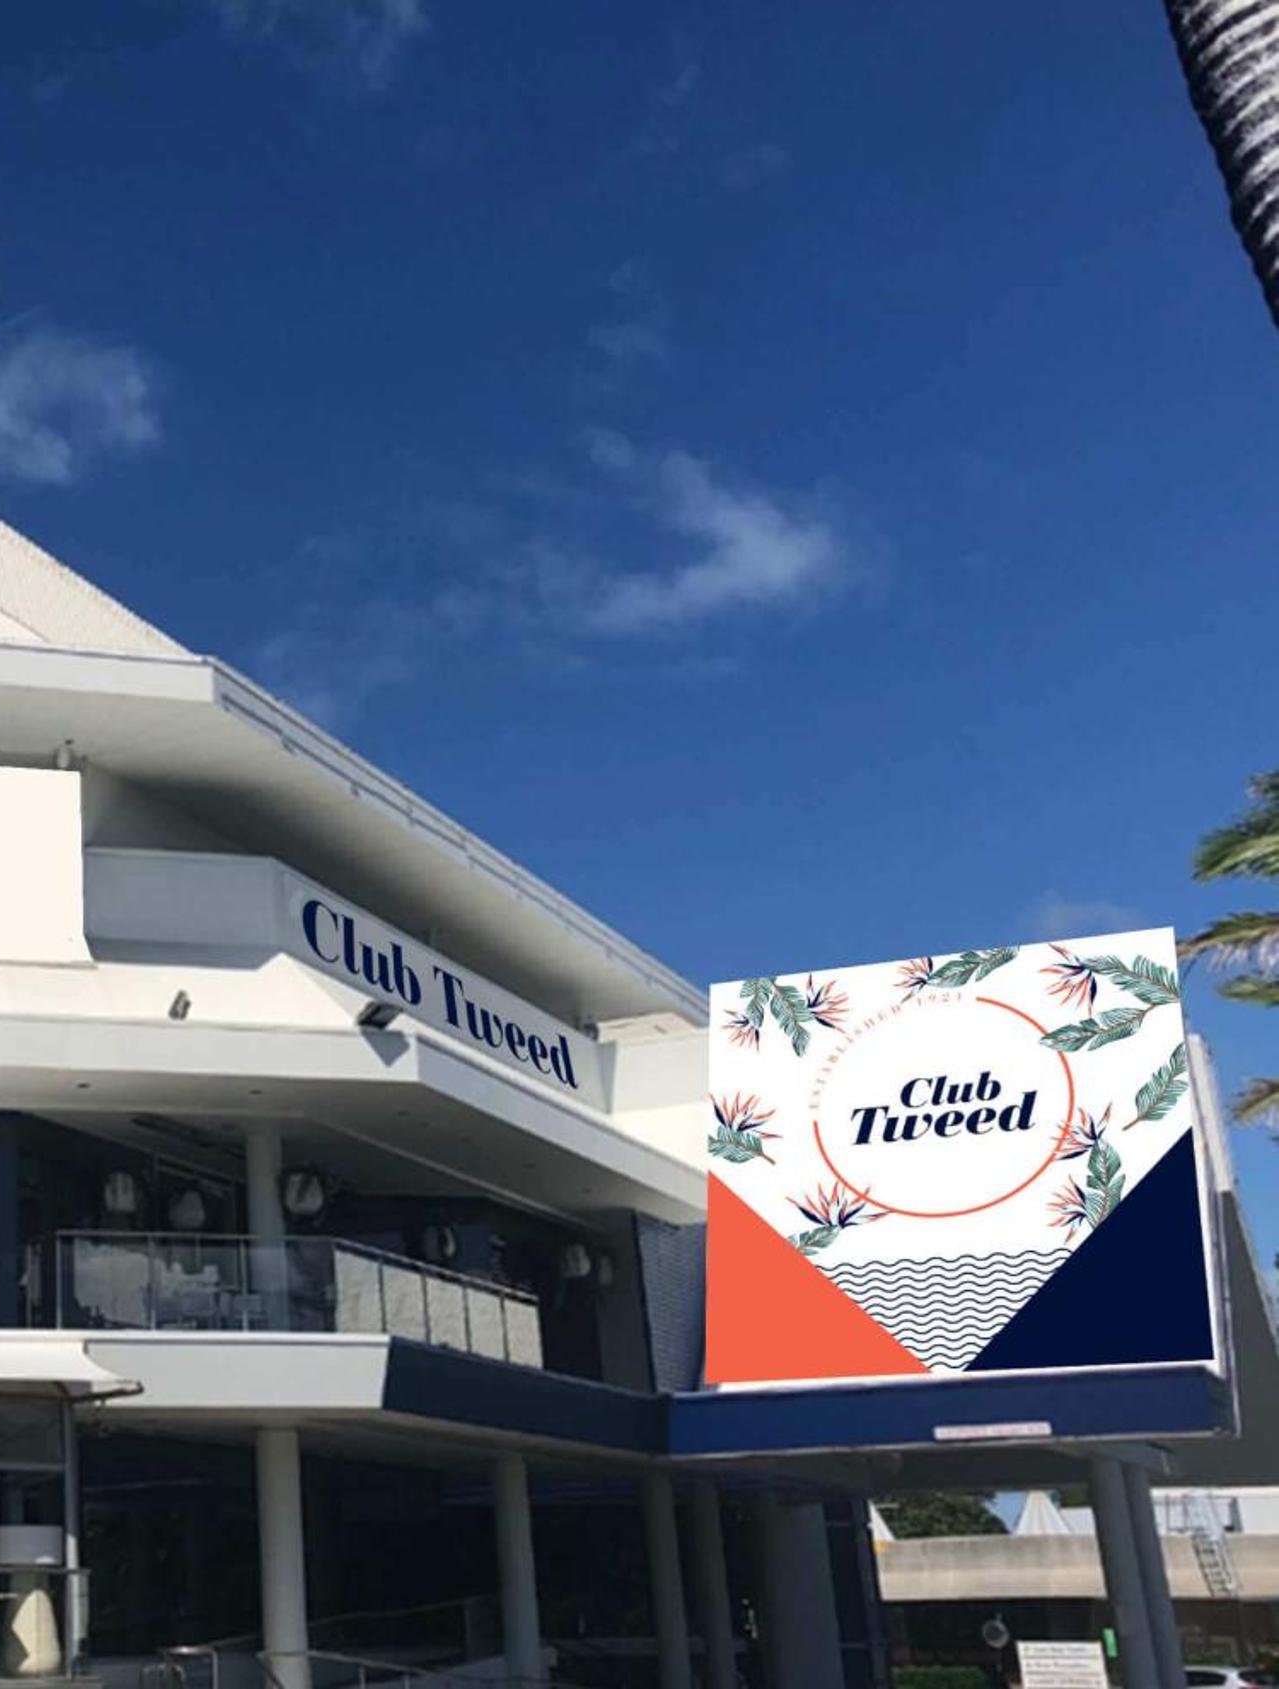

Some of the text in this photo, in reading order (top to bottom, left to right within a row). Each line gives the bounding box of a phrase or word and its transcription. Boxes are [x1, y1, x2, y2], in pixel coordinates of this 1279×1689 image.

[302, 899, 579, 1089] Club Tweed
[900, 1070, 1002, 1109] Club
[850, 1090, 1038, 1146] Tweed
